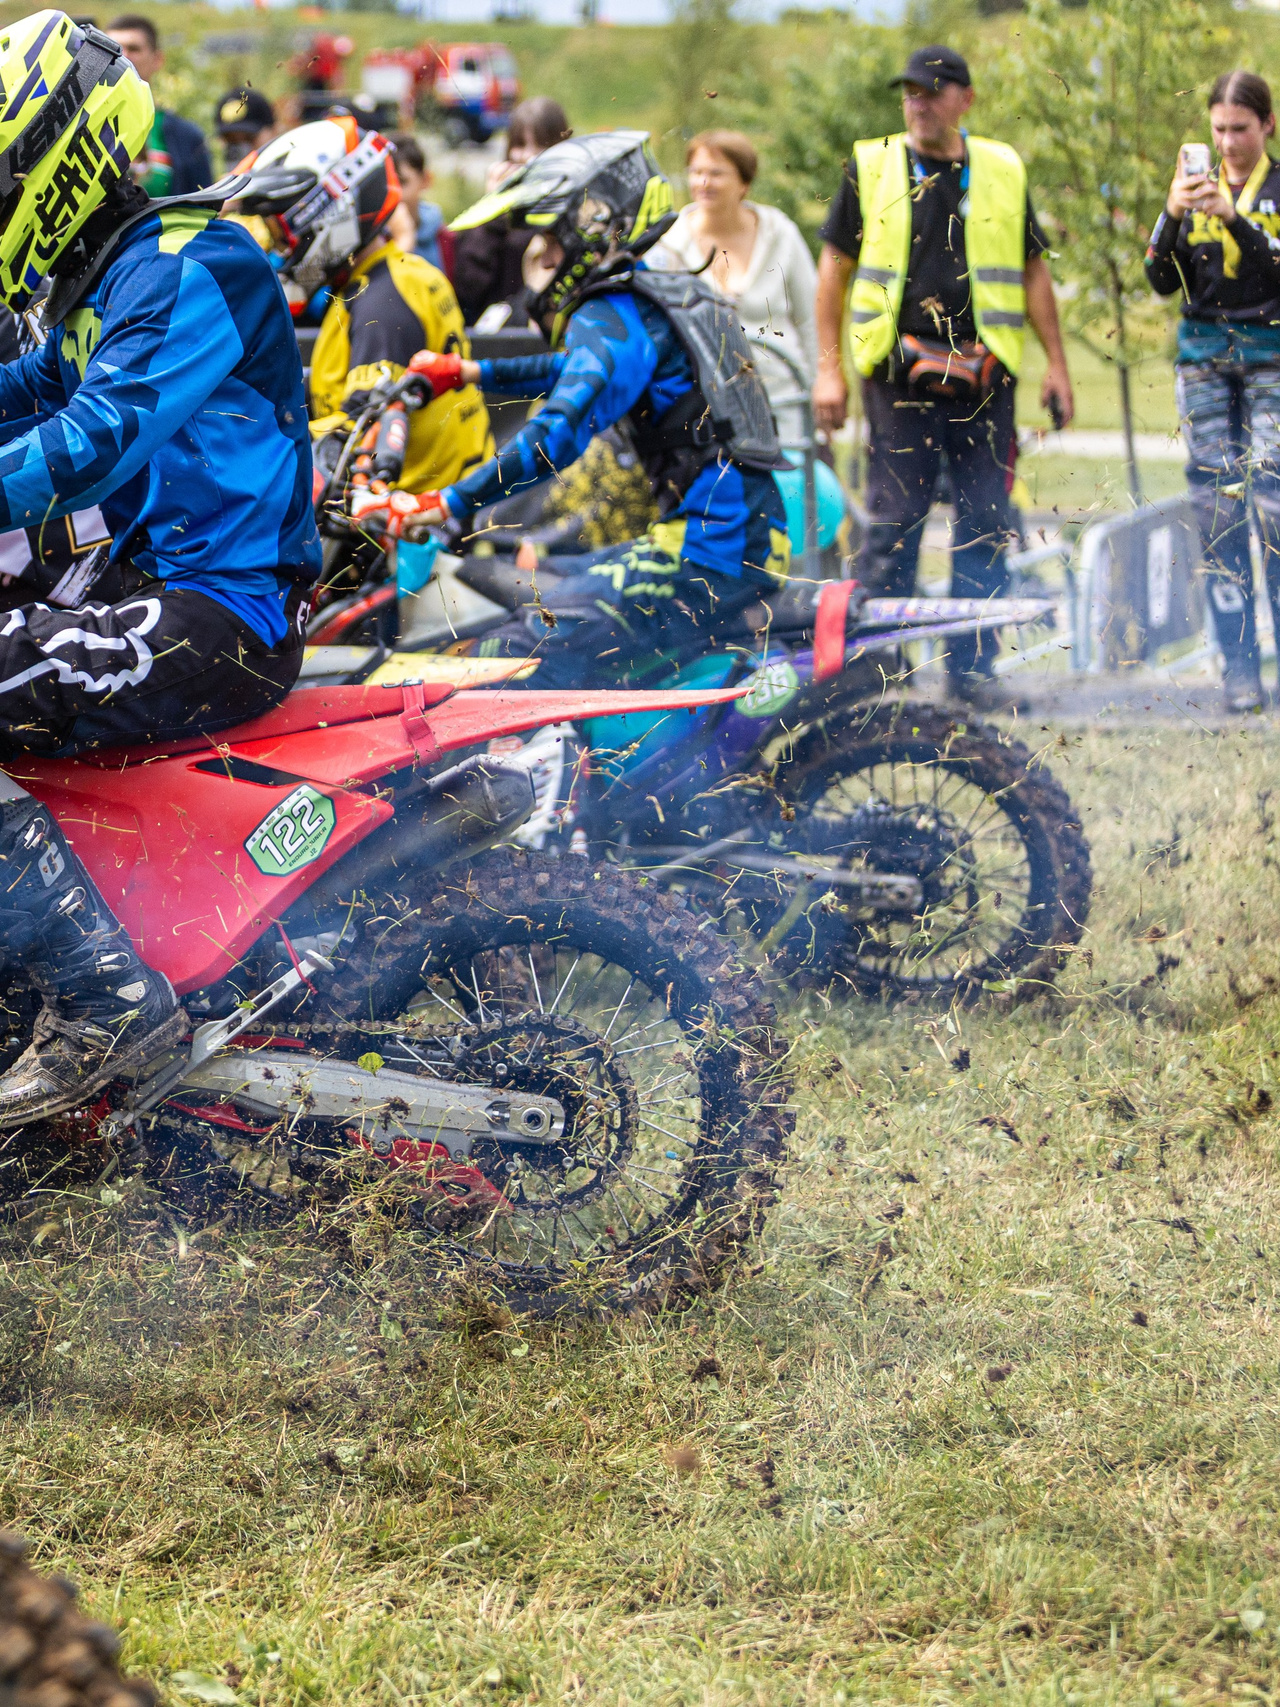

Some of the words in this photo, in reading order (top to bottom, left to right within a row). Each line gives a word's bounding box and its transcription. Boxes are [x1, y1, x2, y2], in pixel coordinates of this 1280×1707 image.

[9, 60, 84, 179] LEATT
[34, 112, 104, 261] LEATT
[259, 796, 326, 867] 122
[288, 846, 310, 867] ENDURO
[309, 826, 327, 848] JUNIOR
[309, 847, 318, 857] J2
